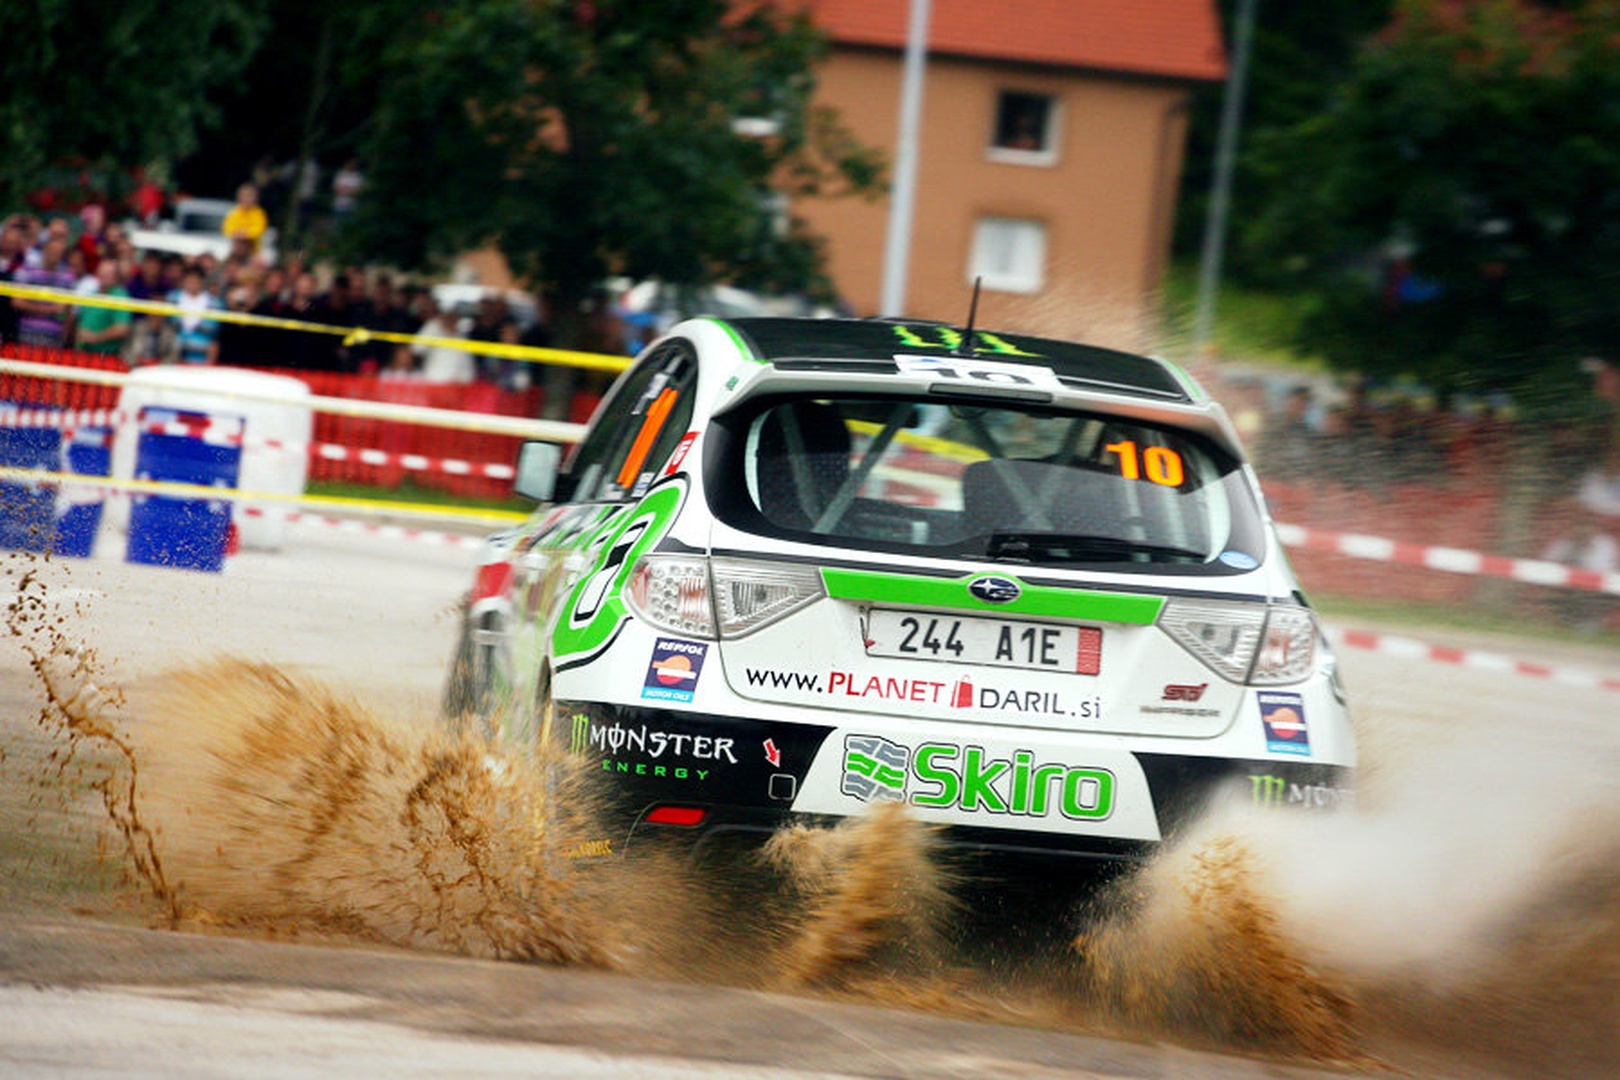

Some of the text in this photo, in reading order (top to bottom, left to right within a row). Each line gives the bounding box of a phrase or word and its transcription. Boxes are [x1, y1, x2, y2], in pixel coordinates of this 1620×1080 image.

[1105, 440, 1185, 487] 10
[657, 641, 704, 656] REPSOL
[899, 616, 1062, 666] 244 A1E
[601, 758, 709, 781] ENERGY
[911, 743, 1117, 822] Skiro
